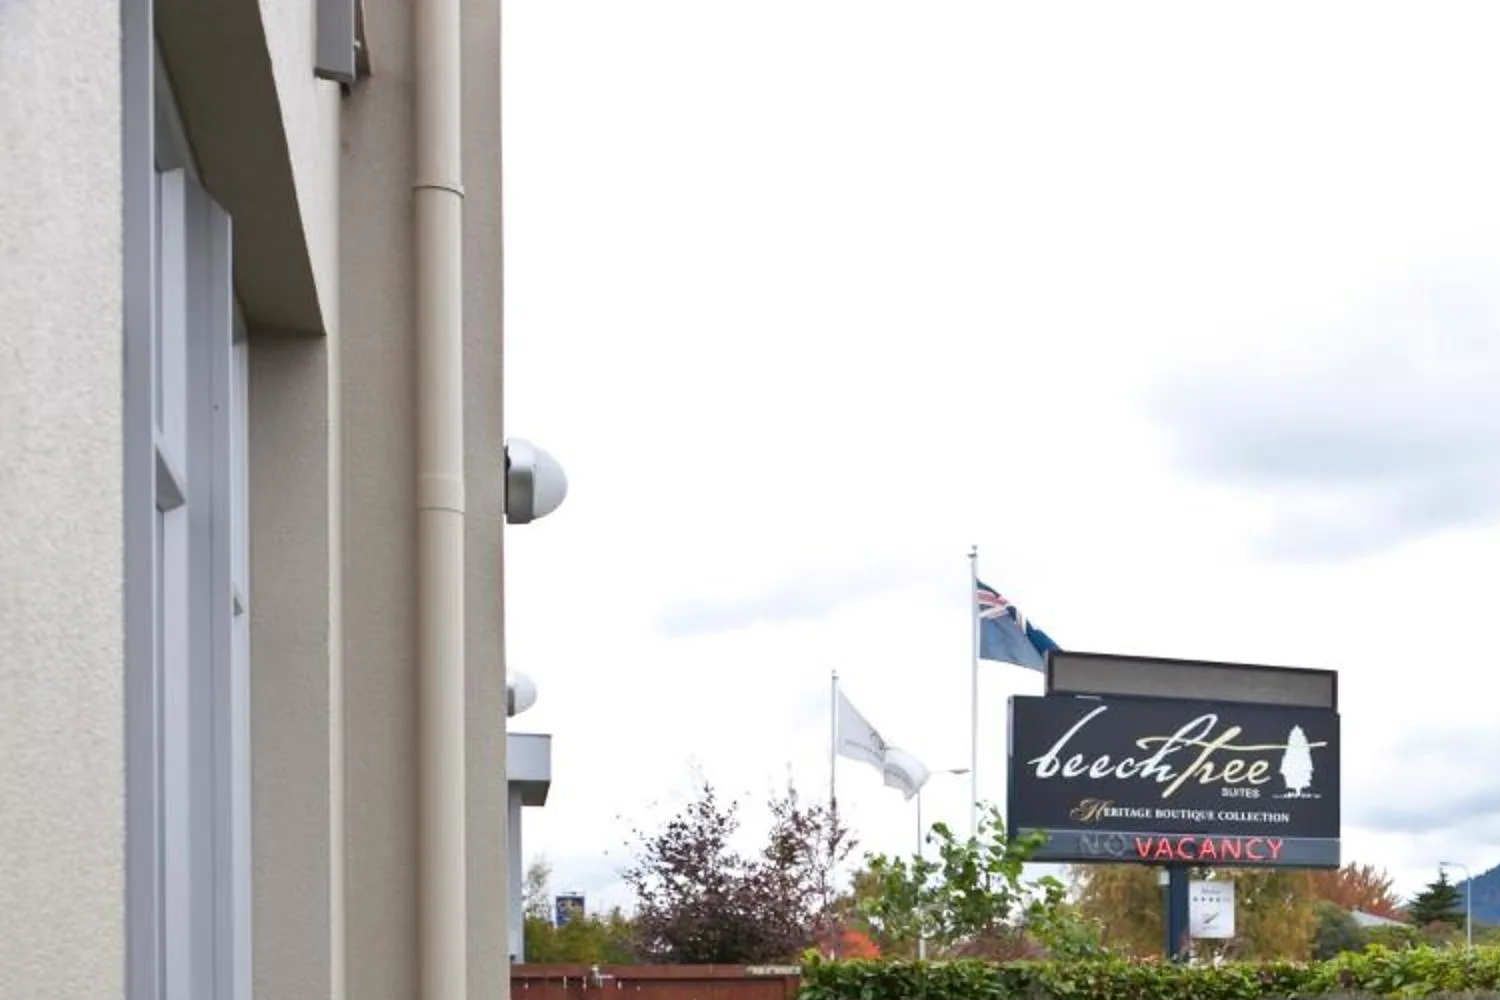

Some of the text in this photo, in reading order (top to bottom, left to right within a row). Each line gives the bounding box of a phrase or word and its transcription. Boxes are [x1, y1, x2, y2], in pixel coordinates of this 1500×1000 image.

[1221, 787, 1261, 799] SUITES
[1070, 799, 1290, 823] HERITAGE BOUTIQUE COLLECTION
[1080, 834, 1283, 860] NO VACANCY
